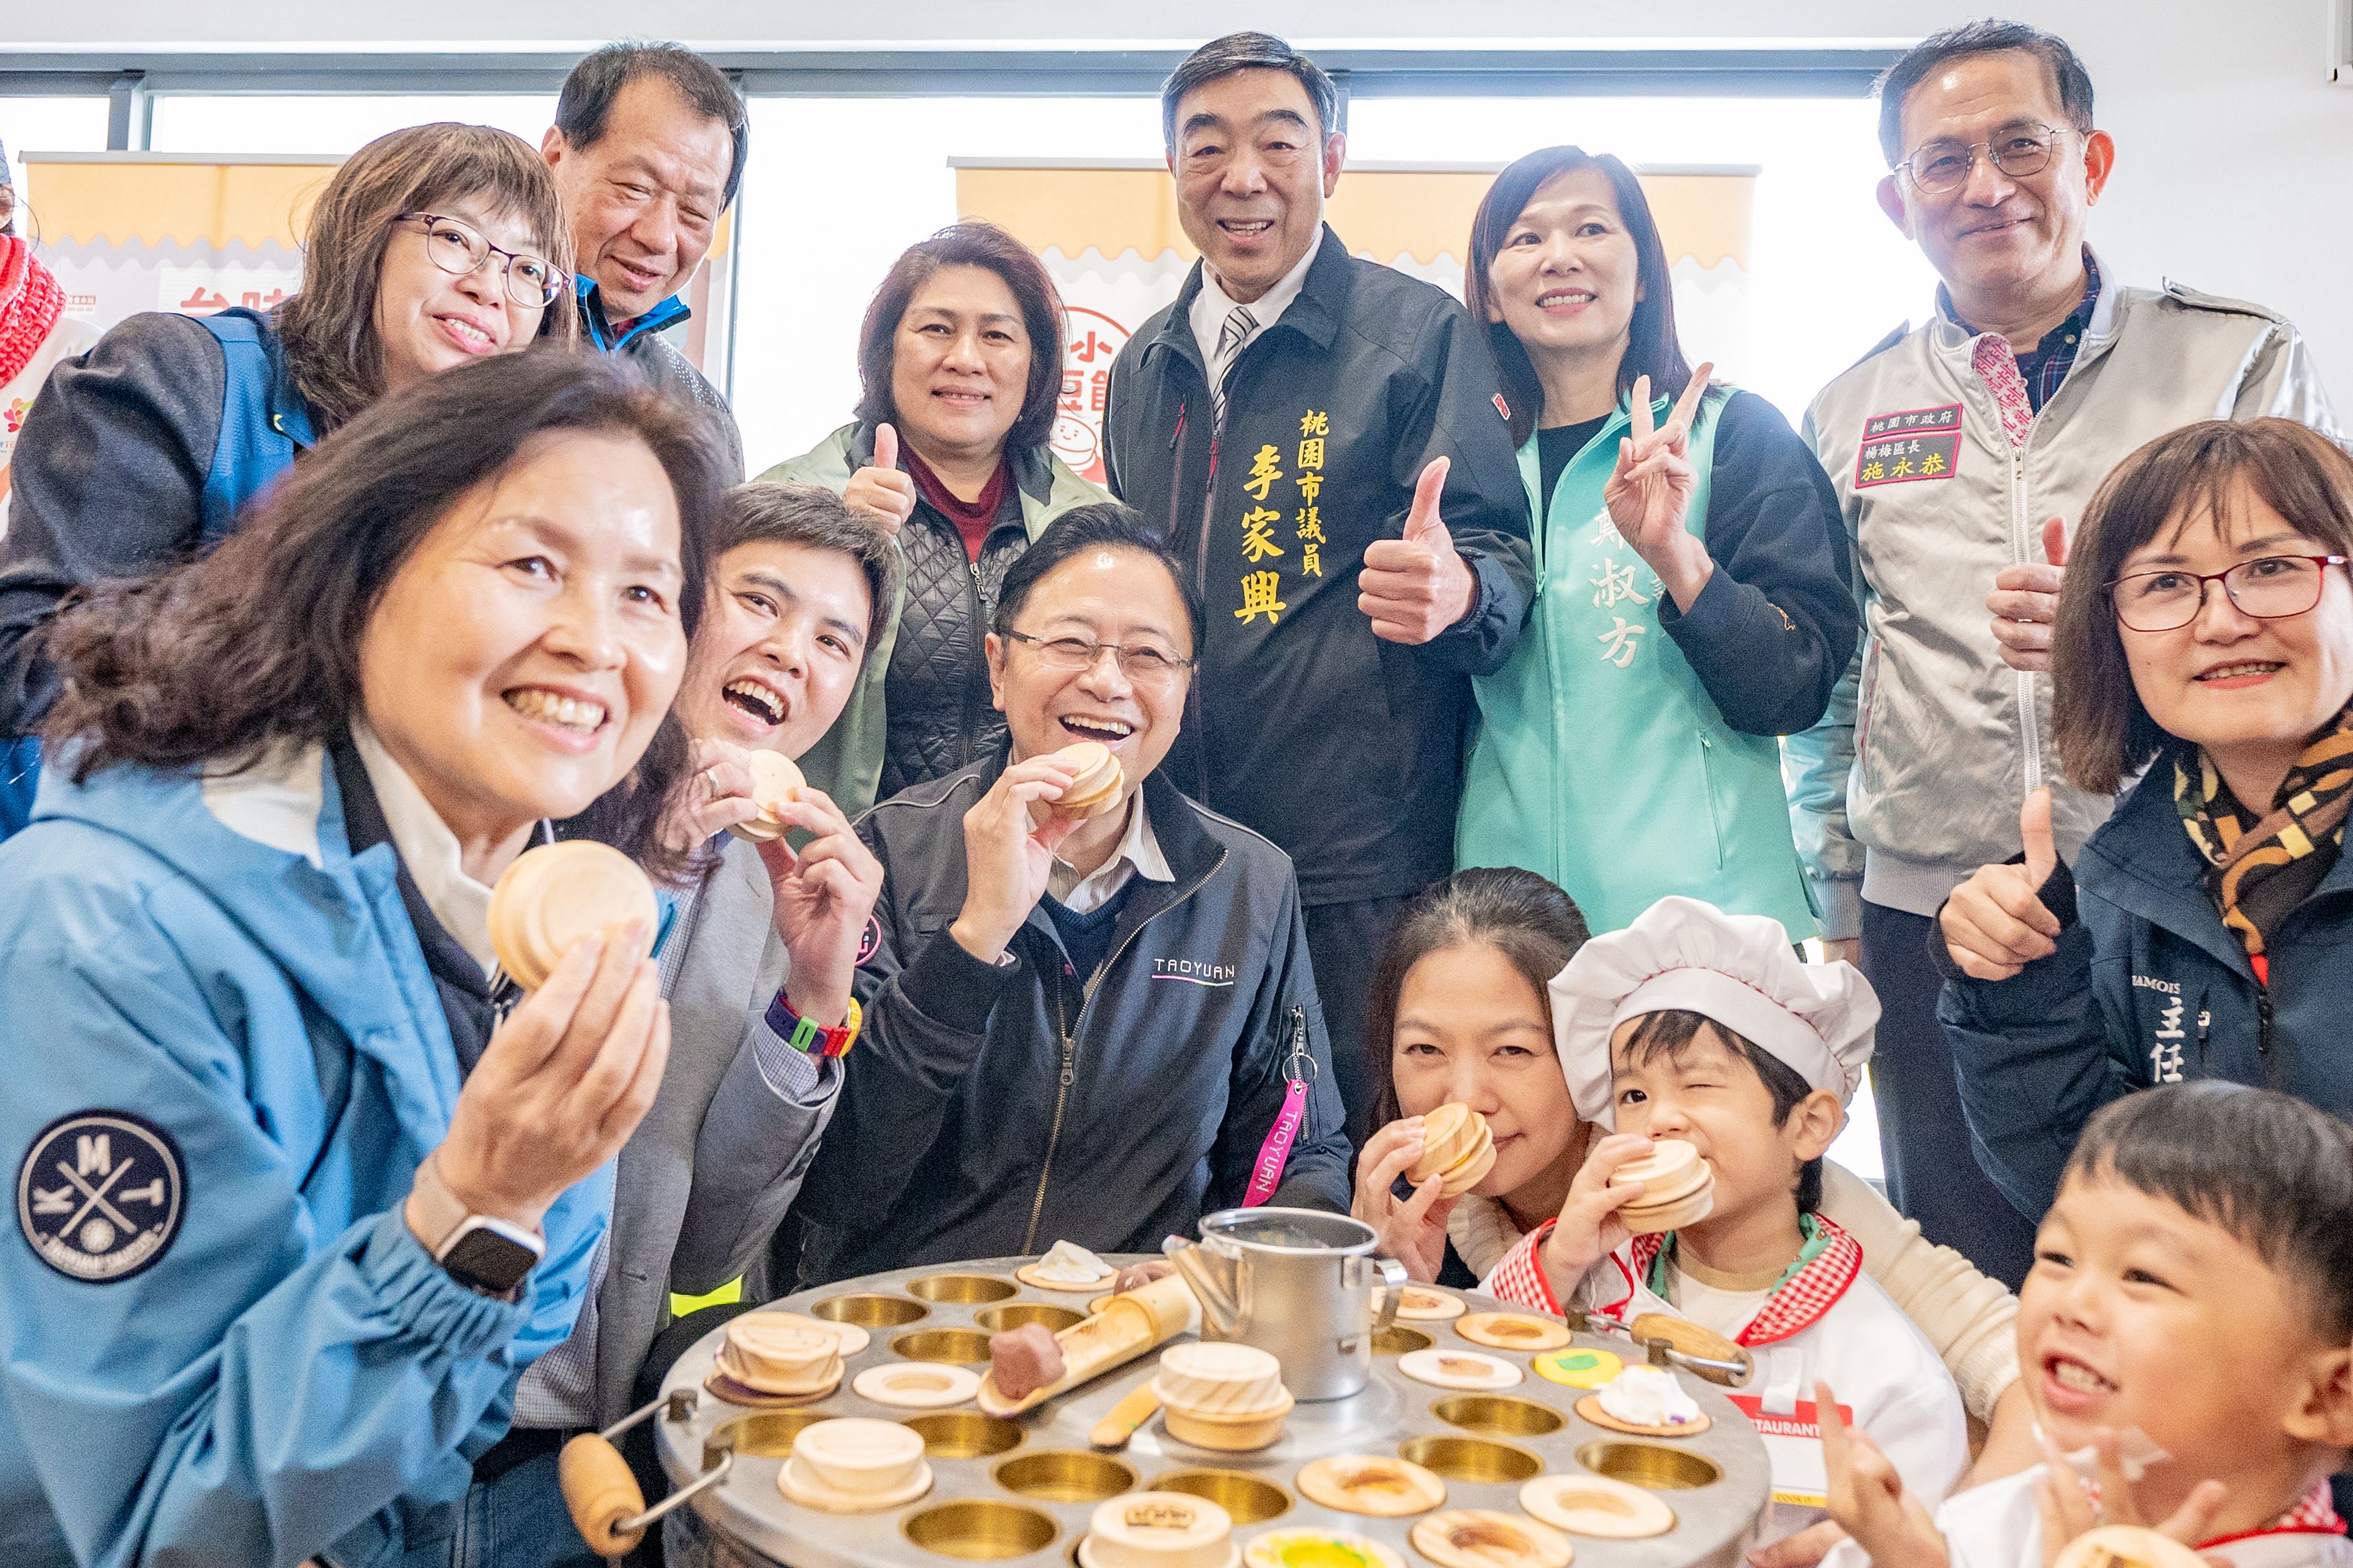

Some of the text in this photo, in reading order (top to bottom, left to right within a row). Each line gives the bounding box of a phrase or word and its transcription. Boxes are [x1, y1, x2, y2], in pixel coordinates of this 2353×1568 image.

[1069, 331, 1112, 362] 小
[1870, 411, 1953, 433] 桃園市政府
[1864, 439, 1921, 460] 楊梅區長
[1860, 452, 1946, 482] 施永恭
[1296, 409, 1330, 577] 桃園市議員
[1234, 444, 1287, 625] 李家興
[1153, 958, 1235, 980] TAOYUAN
[2149, 996, 2185, 1083] 主任
[1256, 1111, 1299, 1193] TAOYUAN
